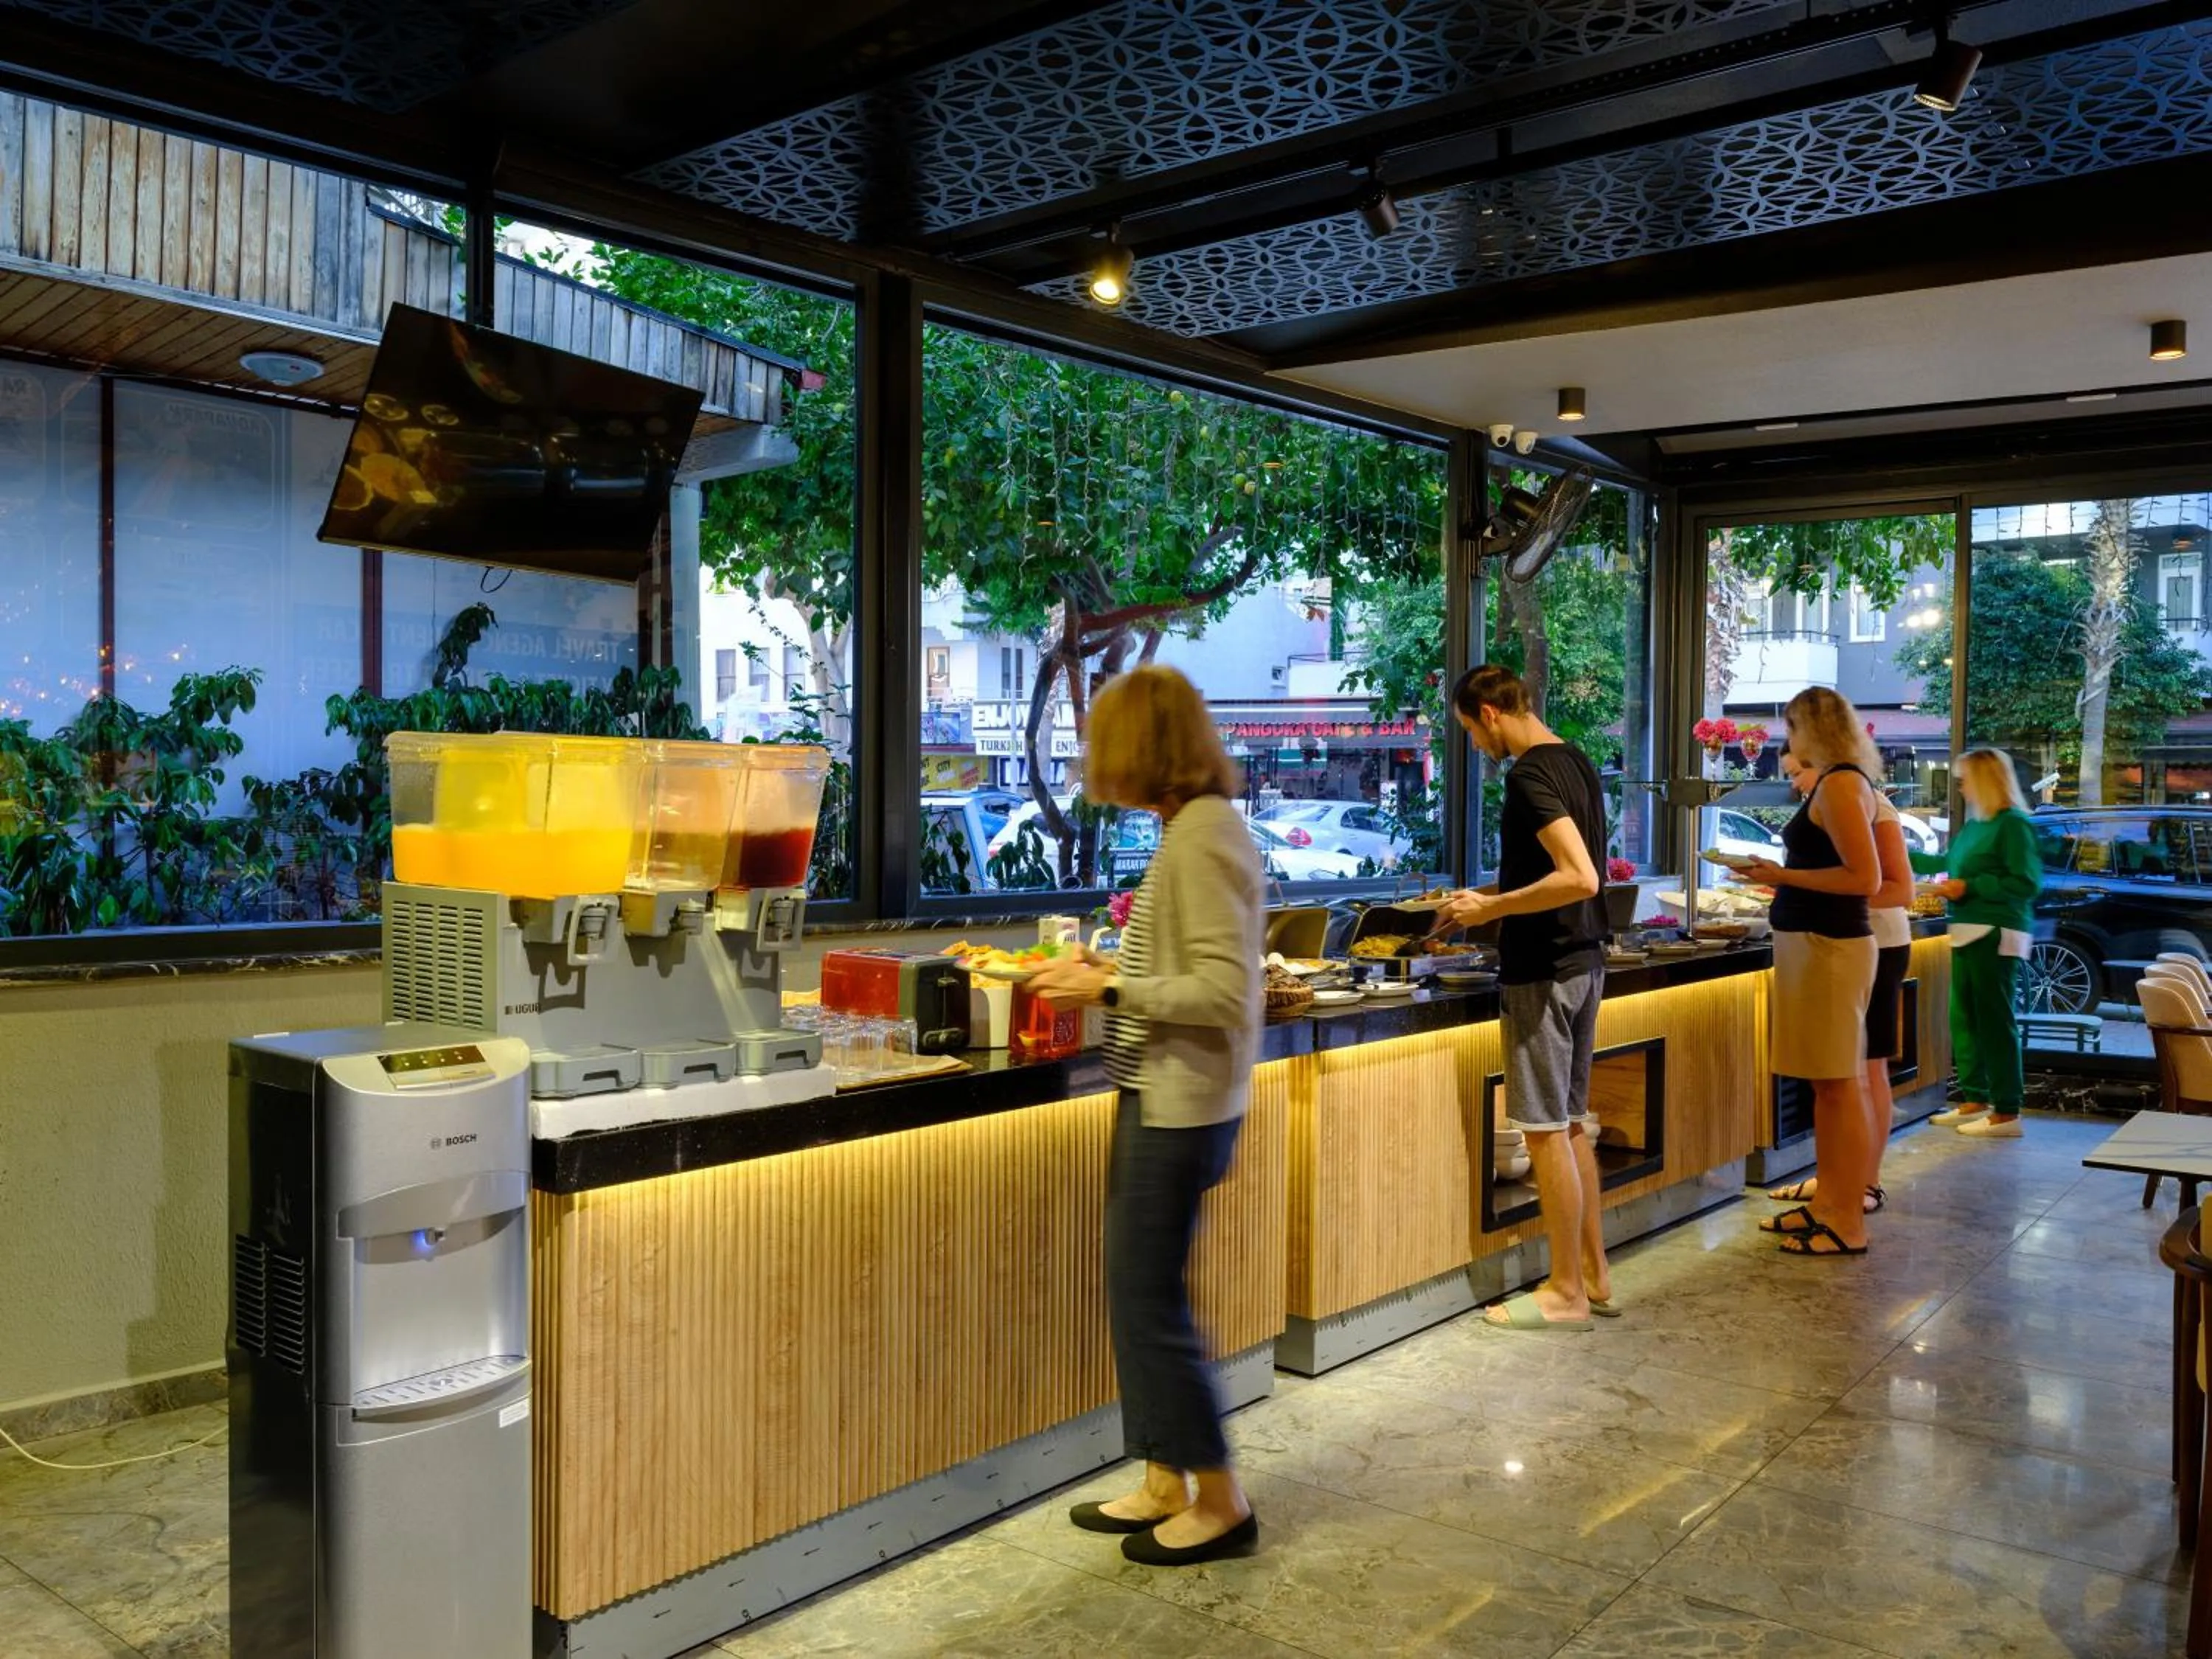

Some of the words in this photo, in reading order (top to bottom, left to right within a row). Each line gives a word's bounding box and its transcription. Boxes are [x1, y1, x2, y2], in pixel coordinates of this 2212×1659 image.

[1380, 718, 1416, 736] BAR
[980, 740, 1023, 751] TURKIH
[445, 1133, 478, 1147] BOSCH
